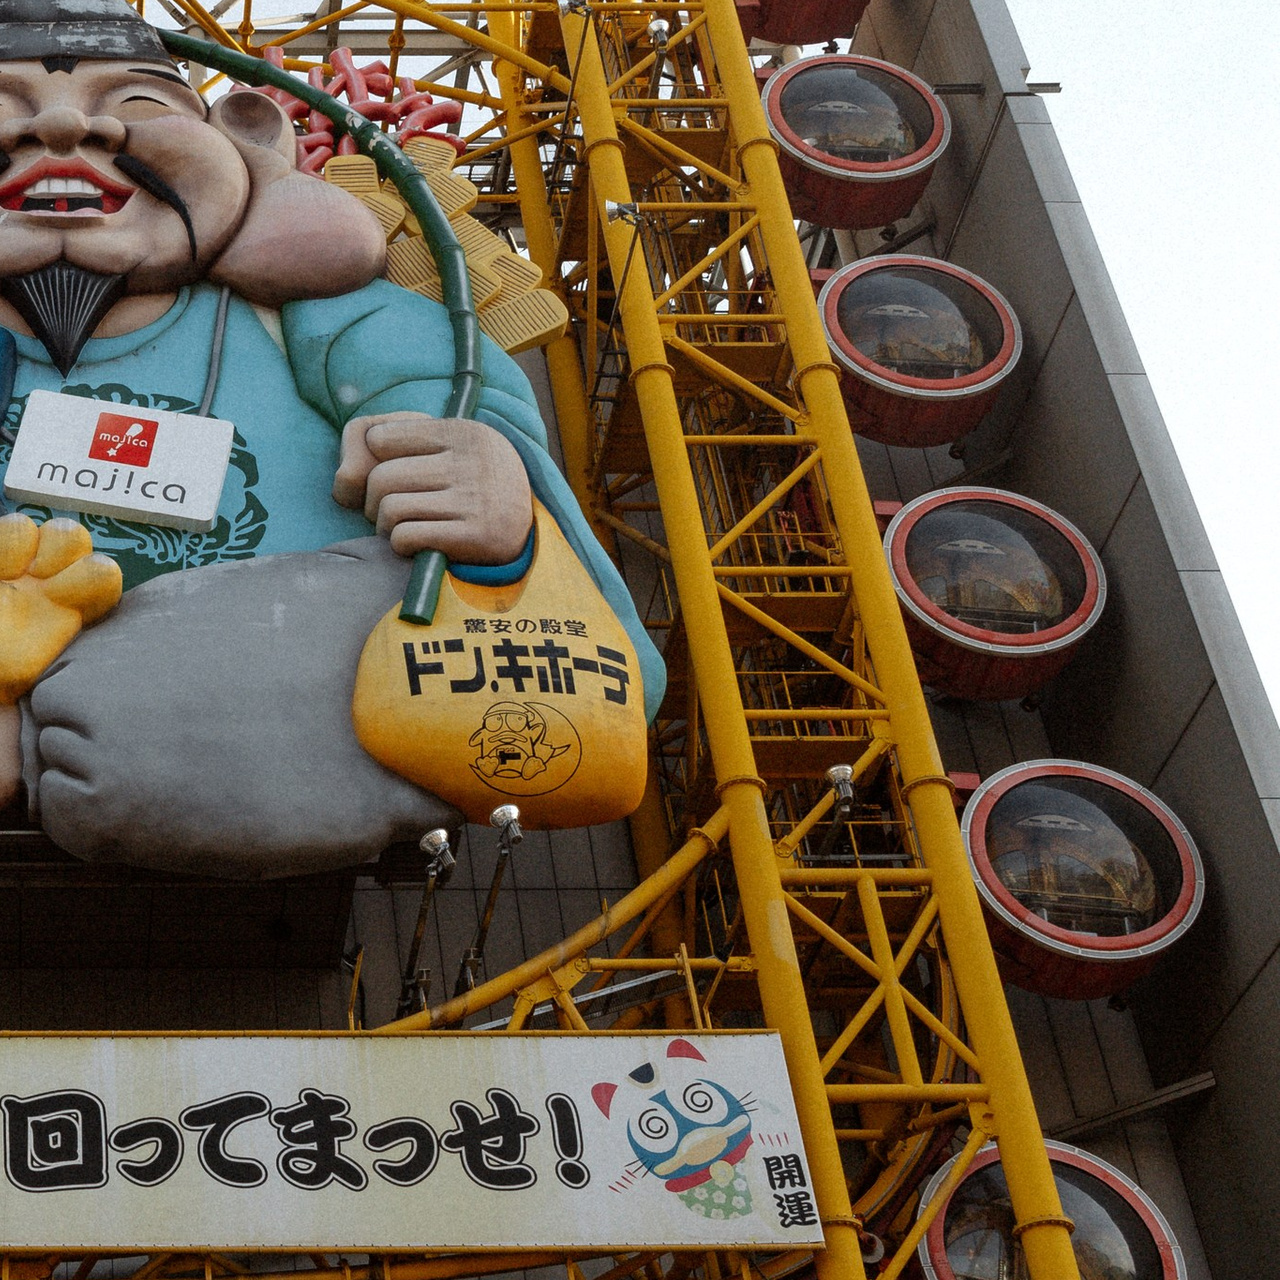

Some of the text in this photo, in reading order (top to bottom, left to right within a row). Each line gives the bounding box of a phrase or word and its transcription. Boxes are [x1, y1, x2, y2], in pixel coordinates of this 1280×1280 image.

[463, 618, 588, 638] 驚安の殿堂
[762, 1153, 819, 1230] 開運
